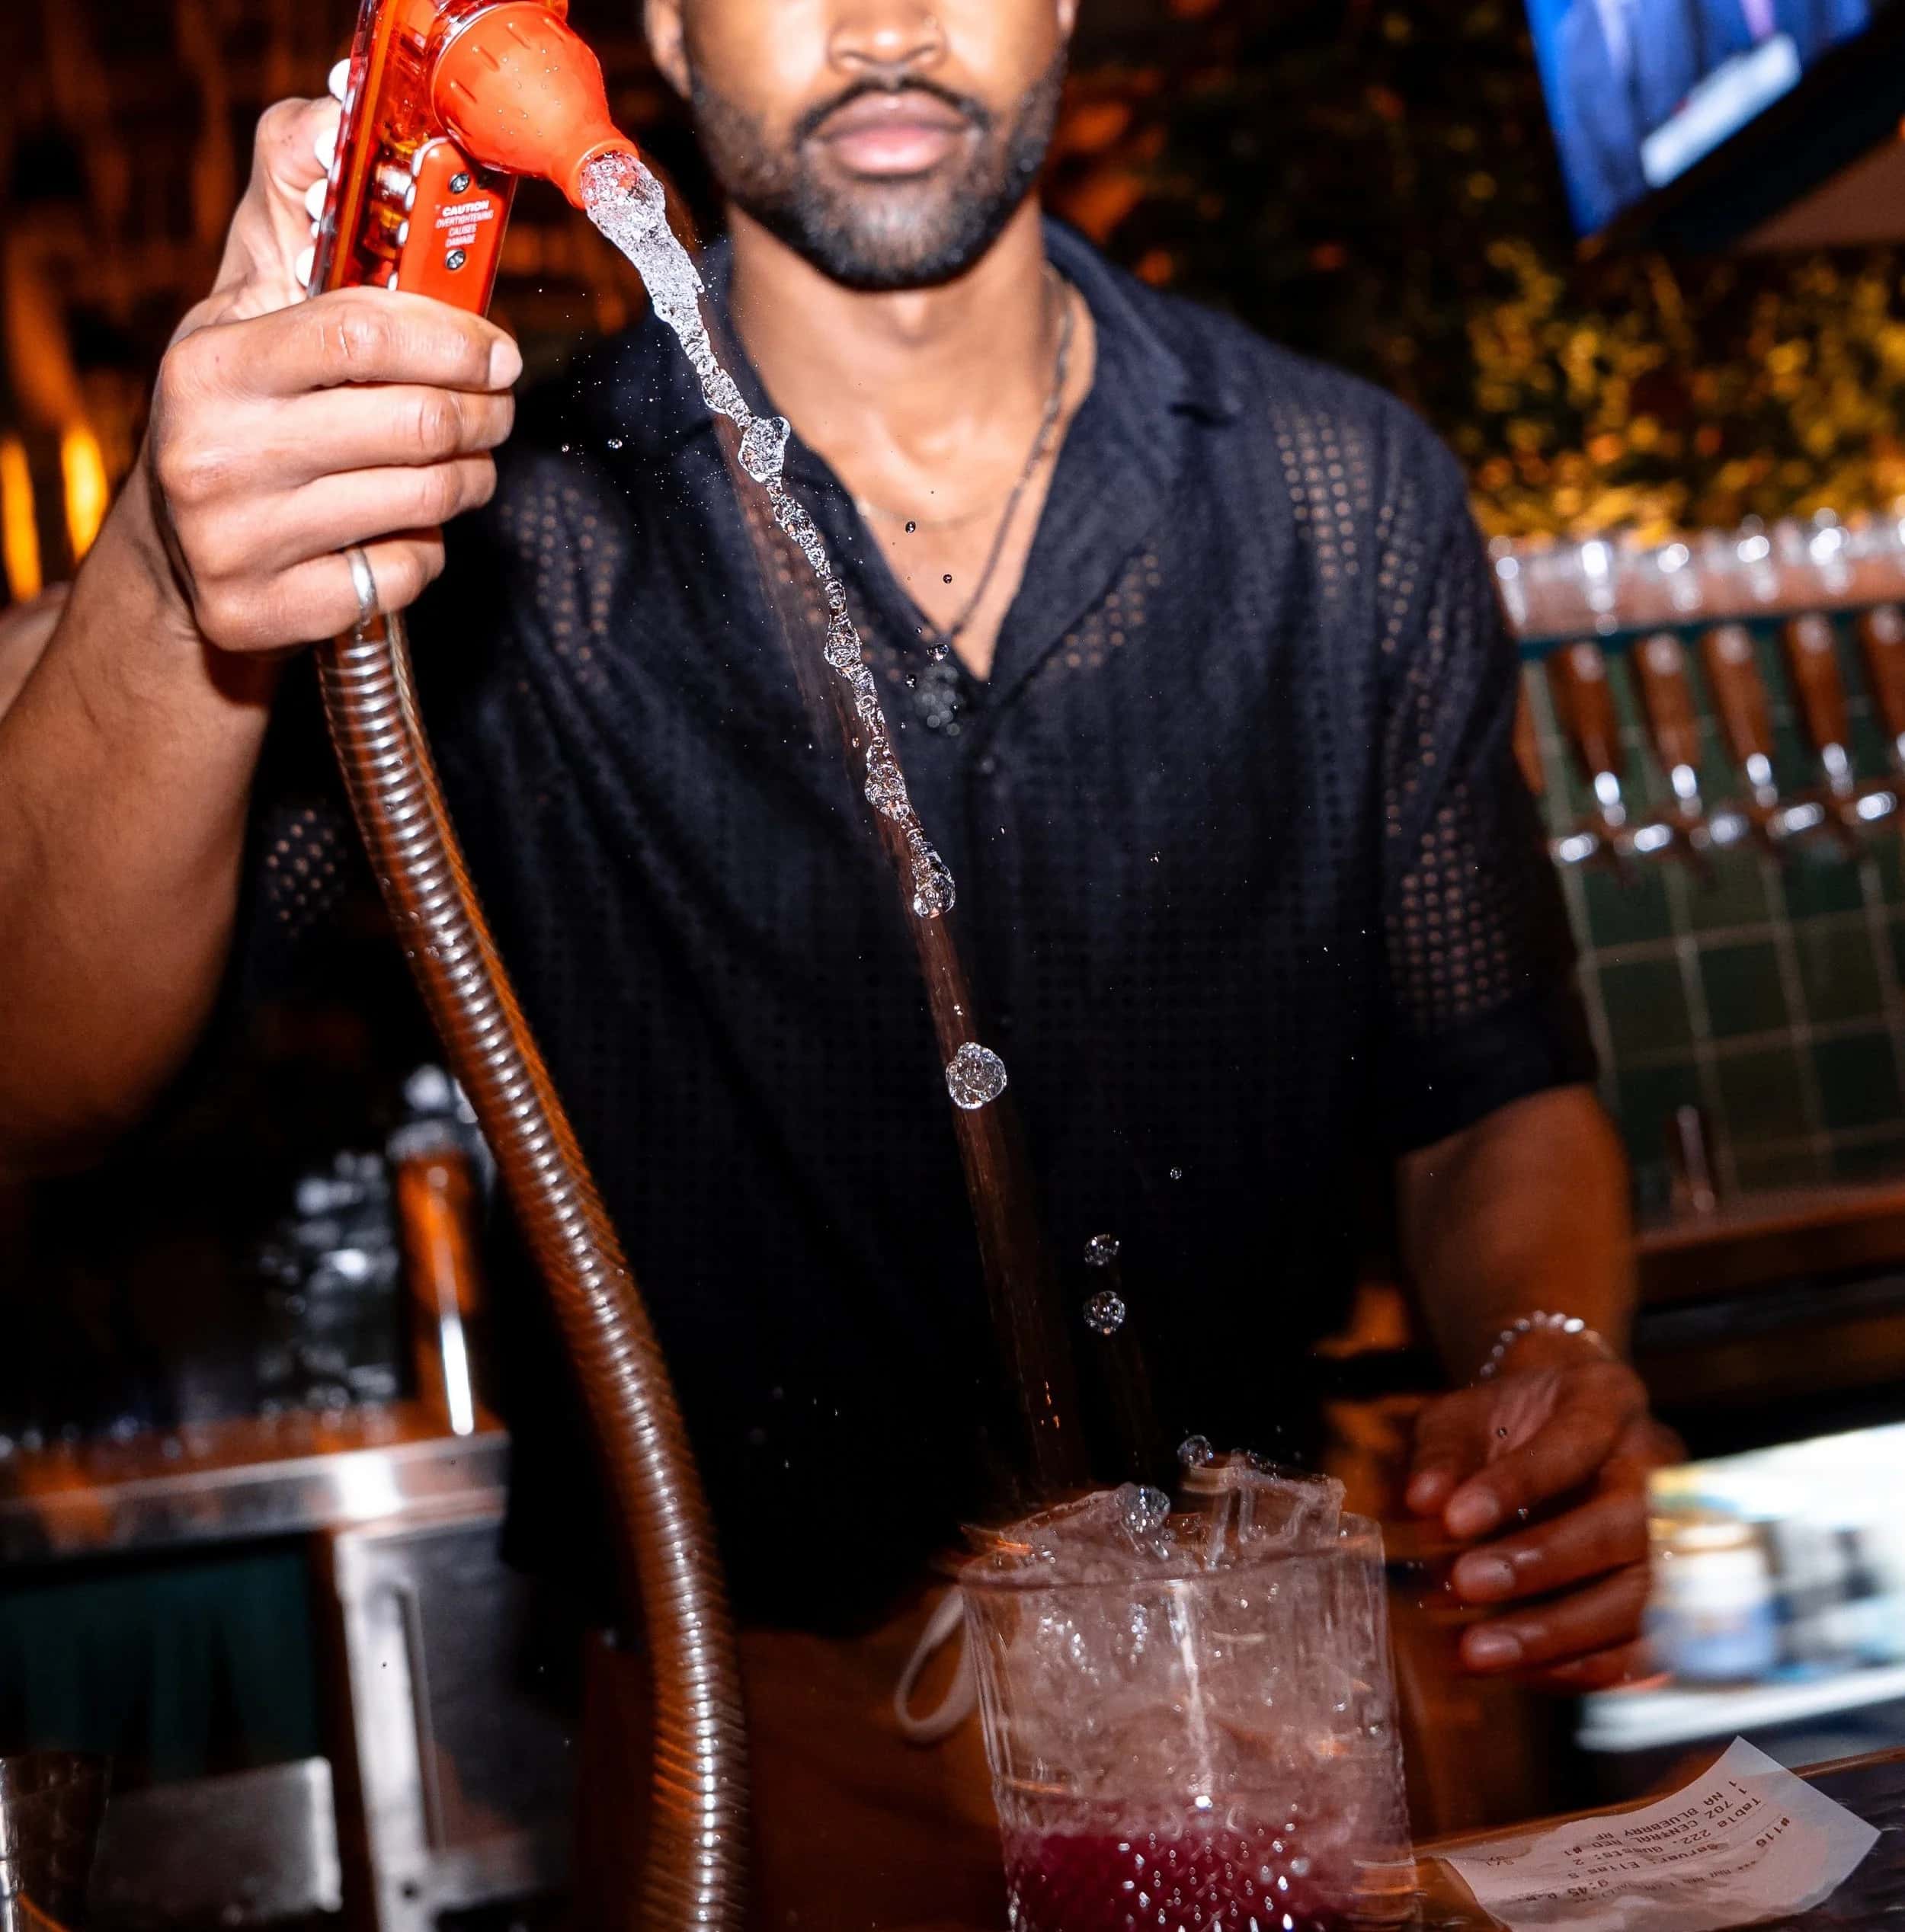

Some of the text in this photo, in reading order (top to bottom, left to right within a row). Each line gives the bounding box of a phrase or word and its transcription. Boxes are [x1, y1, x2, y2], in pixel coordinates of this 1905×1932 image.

[443, 200, 489, 217] CAUTION
[1703, 1792, 1724, 1806] NA
[1625, 1808, 1699, 1836] BLUEBRRY
[1717, 1797, 1761, 1828] Table
[1629, 1820, 1698, 1844] CENTRAL
[1756, 1817, 1790, 1847] #116
[1564, 1846, 1583, 1856] #1
[1649, 1842, 1718, 1864] Server:
[1587, 1861, 1641, 1874] Elias
[1567, 1879, 1609, 1898] 9:45
